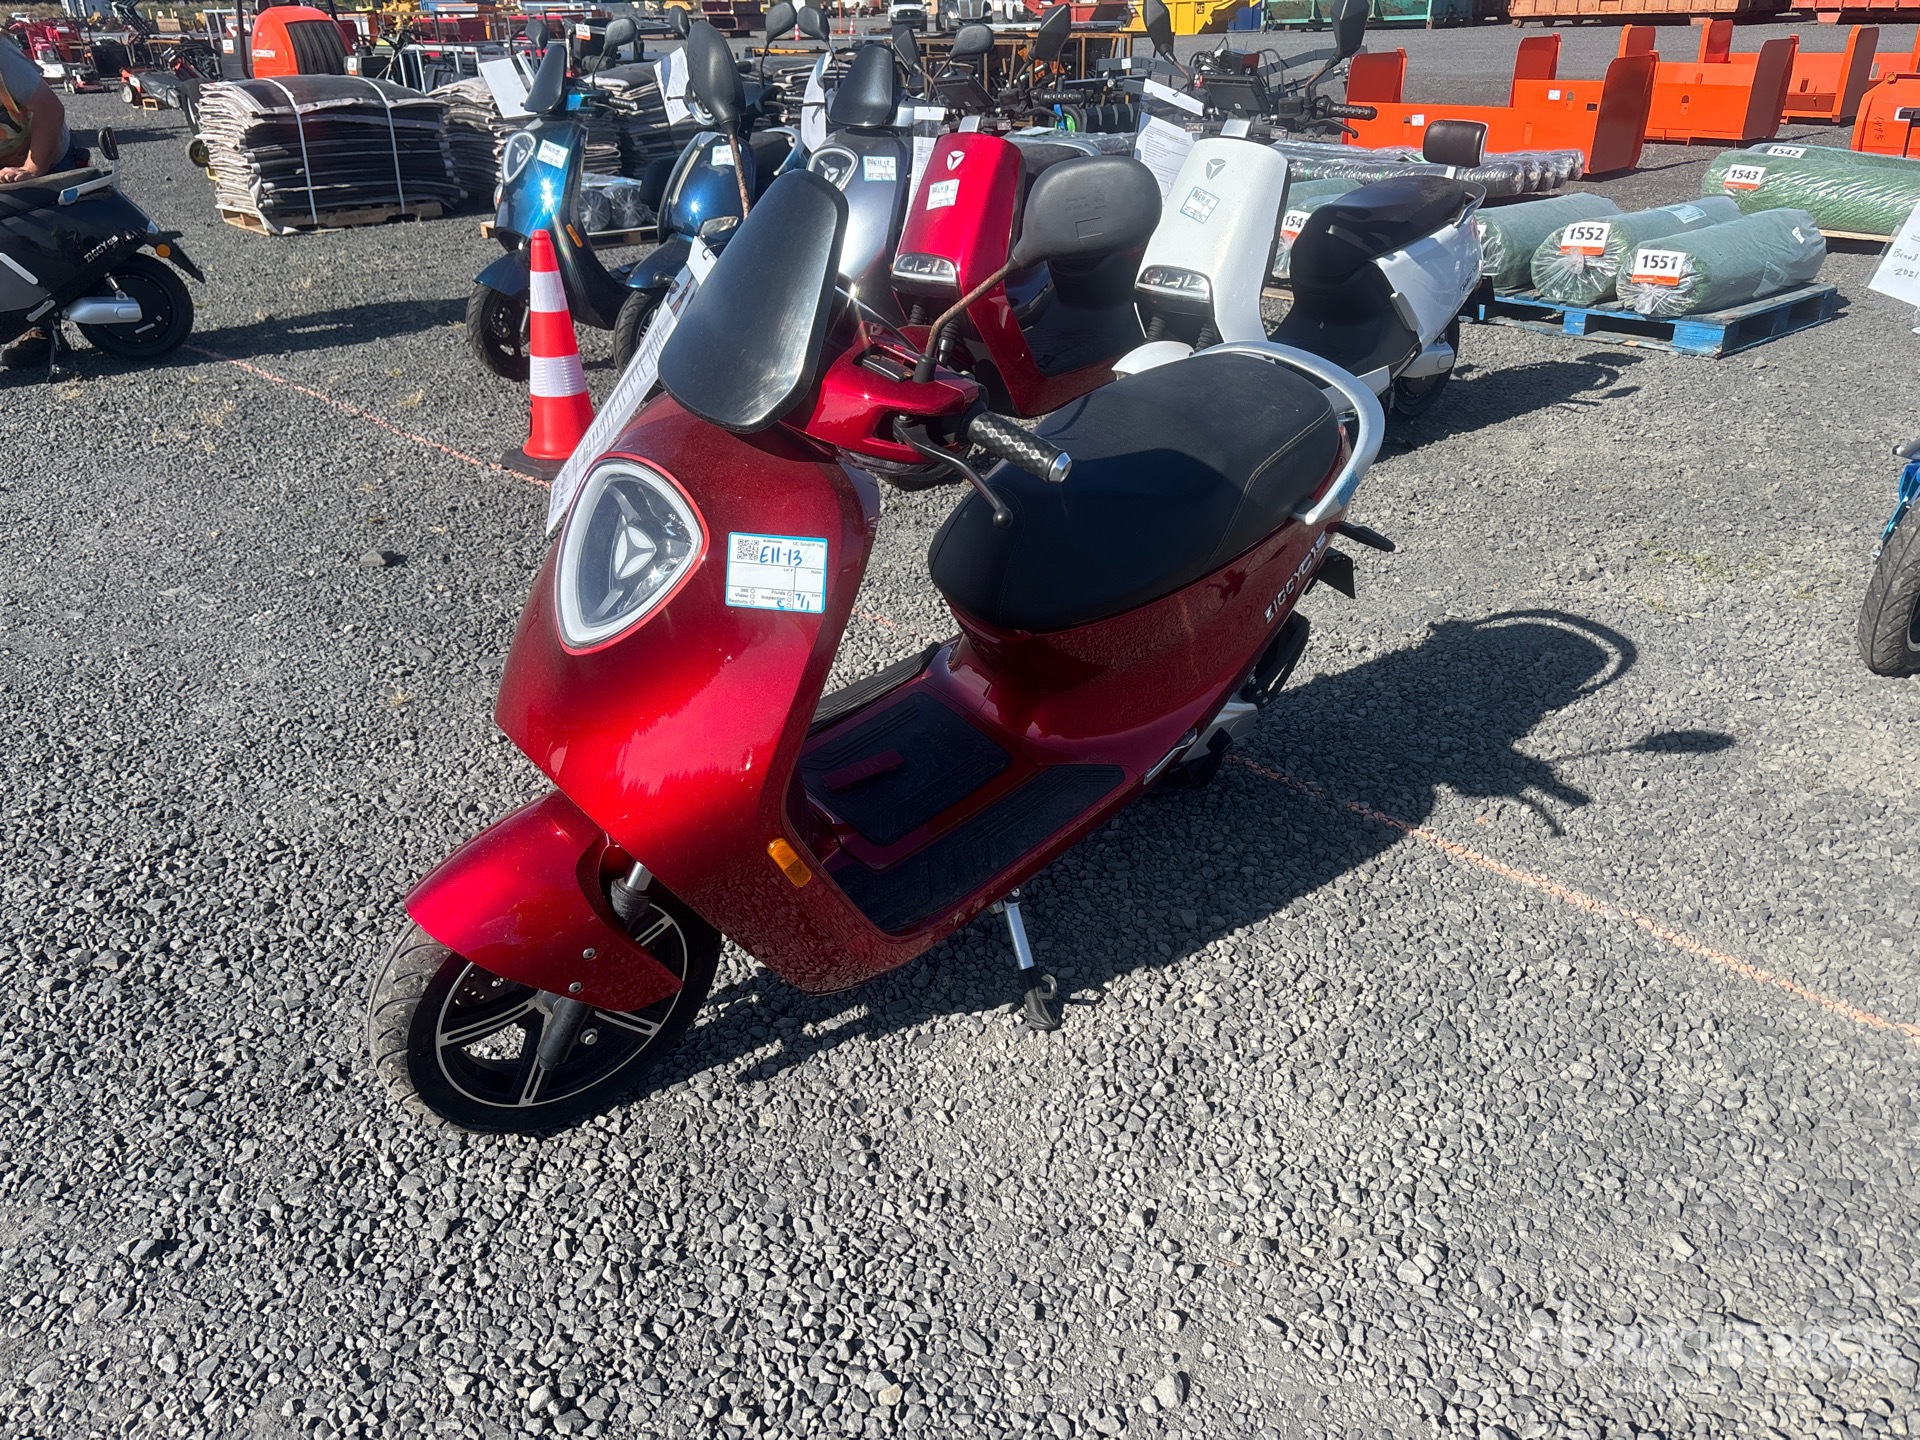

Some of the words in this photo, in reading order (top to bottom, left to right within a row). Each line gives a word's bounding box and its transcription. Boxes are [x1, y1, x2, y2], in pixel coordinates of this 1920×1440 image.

[1772, 147, 1800, 157] 1542
[1731, 169, 1759, 181] 1543
[1569, 226, 1605, 241] 1552
[1642, 254, 1679, 270] 1551
[760, 545, 802, 566] E11-13
